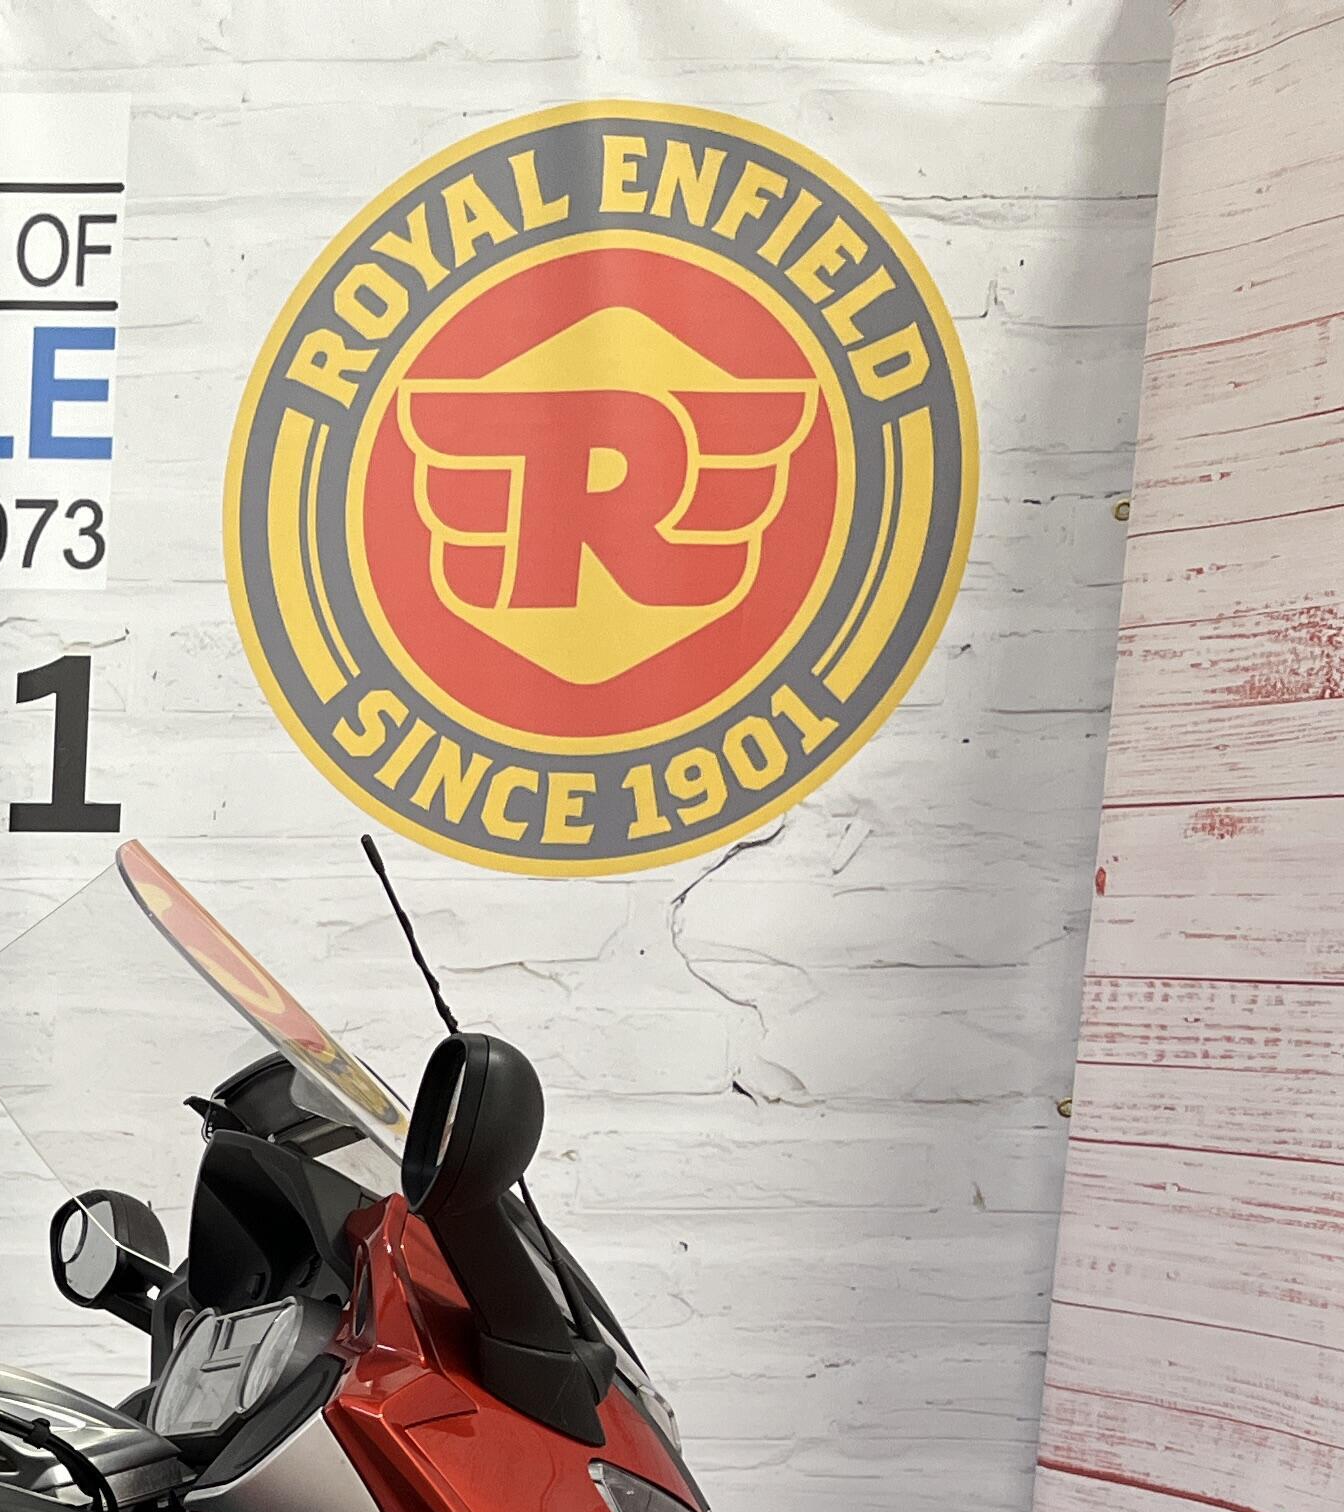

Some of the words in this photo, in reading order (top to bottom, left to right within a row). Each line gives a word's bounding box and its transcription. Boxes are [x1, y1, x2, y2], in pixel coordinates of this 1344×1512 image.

[18, 213, 117, 288] OF
[285, 155, 570, 409] ROYAL
[601, 134, 931, 402] ENFIELD
[332, 688, 595, 845] SINCE
[623, 685, 839, 839] 1901
